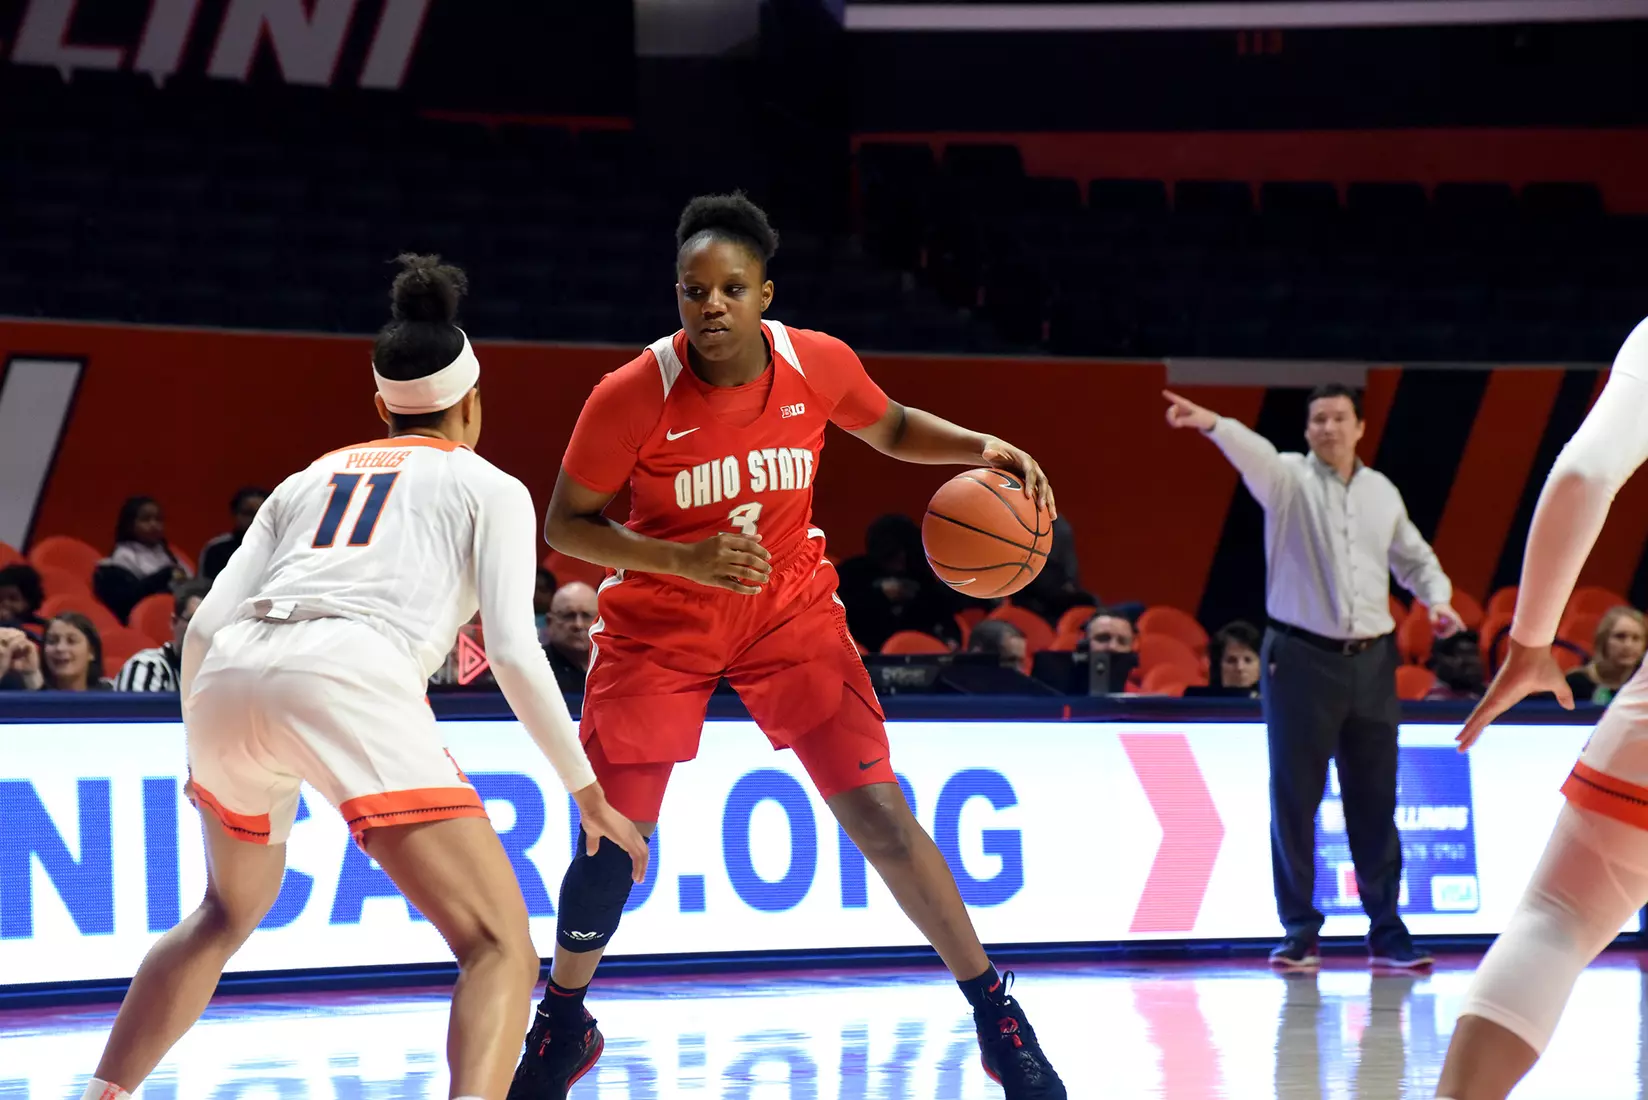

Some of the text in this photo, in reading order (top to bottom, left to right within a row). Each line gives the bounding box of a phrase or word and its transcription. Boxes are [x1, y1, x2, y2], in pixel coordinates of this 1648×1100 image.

[345, 450, 412, 469] PEEBLES
[674, 447, 814, 509] OHIO STATE
[311, 471, 401, 549] 11
[718, 501, 763, 536] 3
